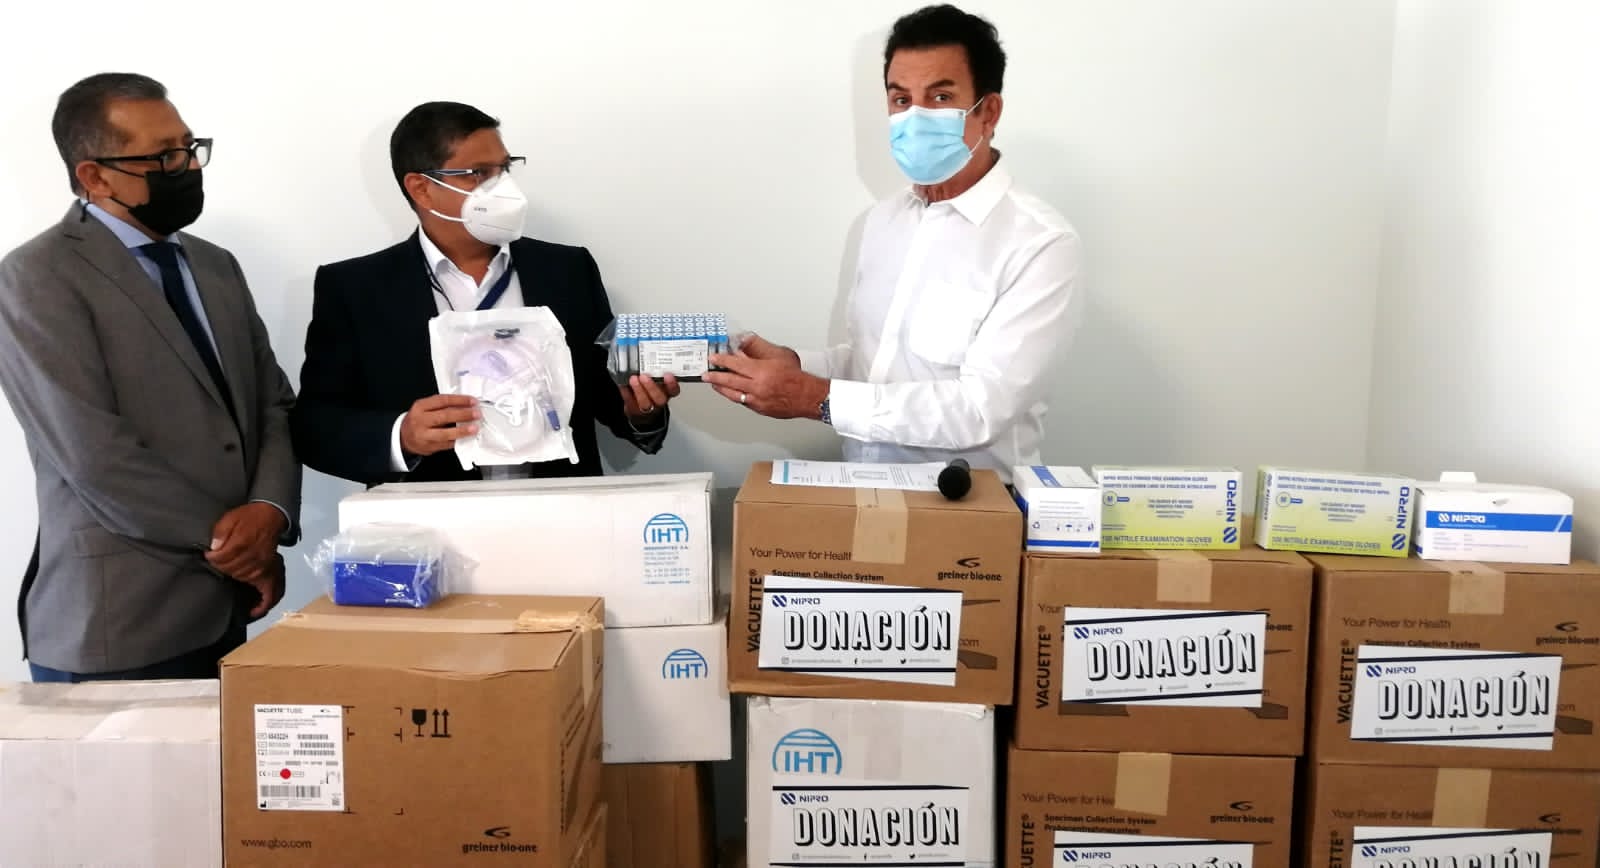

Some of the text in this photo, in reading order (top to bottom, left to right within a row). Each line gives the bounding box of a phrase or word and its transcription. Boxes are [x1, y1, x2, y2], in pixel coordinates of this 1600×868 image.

[1226, 480, 1237, 522] NIPRO
[1396, 486, 1410, 528] NIPRO
[1451, 514, 1486, 524] NIPRO
[652, 528, 684, 543] IHT
[750, 547, 772, 560] Your
[775, 548, 805, 560] Power
[808, 549, 822, 560] for
[812, 571, 853, 580] Collection
[855, 573, 884, 583] System
[938, 571, 970, 581] greiner
[790, 596, 820, 606] NIPRO
[784, 605, 951, 651] DONACIÓN
[1343, 618, 1452, 630] Your Power for Health
[1092, 627, 1123, 636] NIPRO
[1407, 640, 1448, 648] Collection
[1450, 640, 1480, 648] System
[1086, 628, 1257, 682] DONACIÓN
[670, 664, 702, 679] IHT
[1385, 666, 1416, 675] NIPRO
[1378, 670, 1550, 720] DONACIÓN
[784, 750, 834, 774] IHT
[799, 794, 830, 802] NIPRO
[1022, 792, 1044, 803] Your
[1048, 793, 1078, 804] Power
[1081, 794, 1094, 804] for
[793, 802, 959, 847] DONACIÓN
[1044, 814, 1156, 827] Specimen Collection System
[240, 838, 312, 849] www.gbo.com
[462, 842, 538, 854] greiner bio-one
[1081, 850, 1111, 859] NIPRO
[1380, 846, 1410, 854] NIPRO
